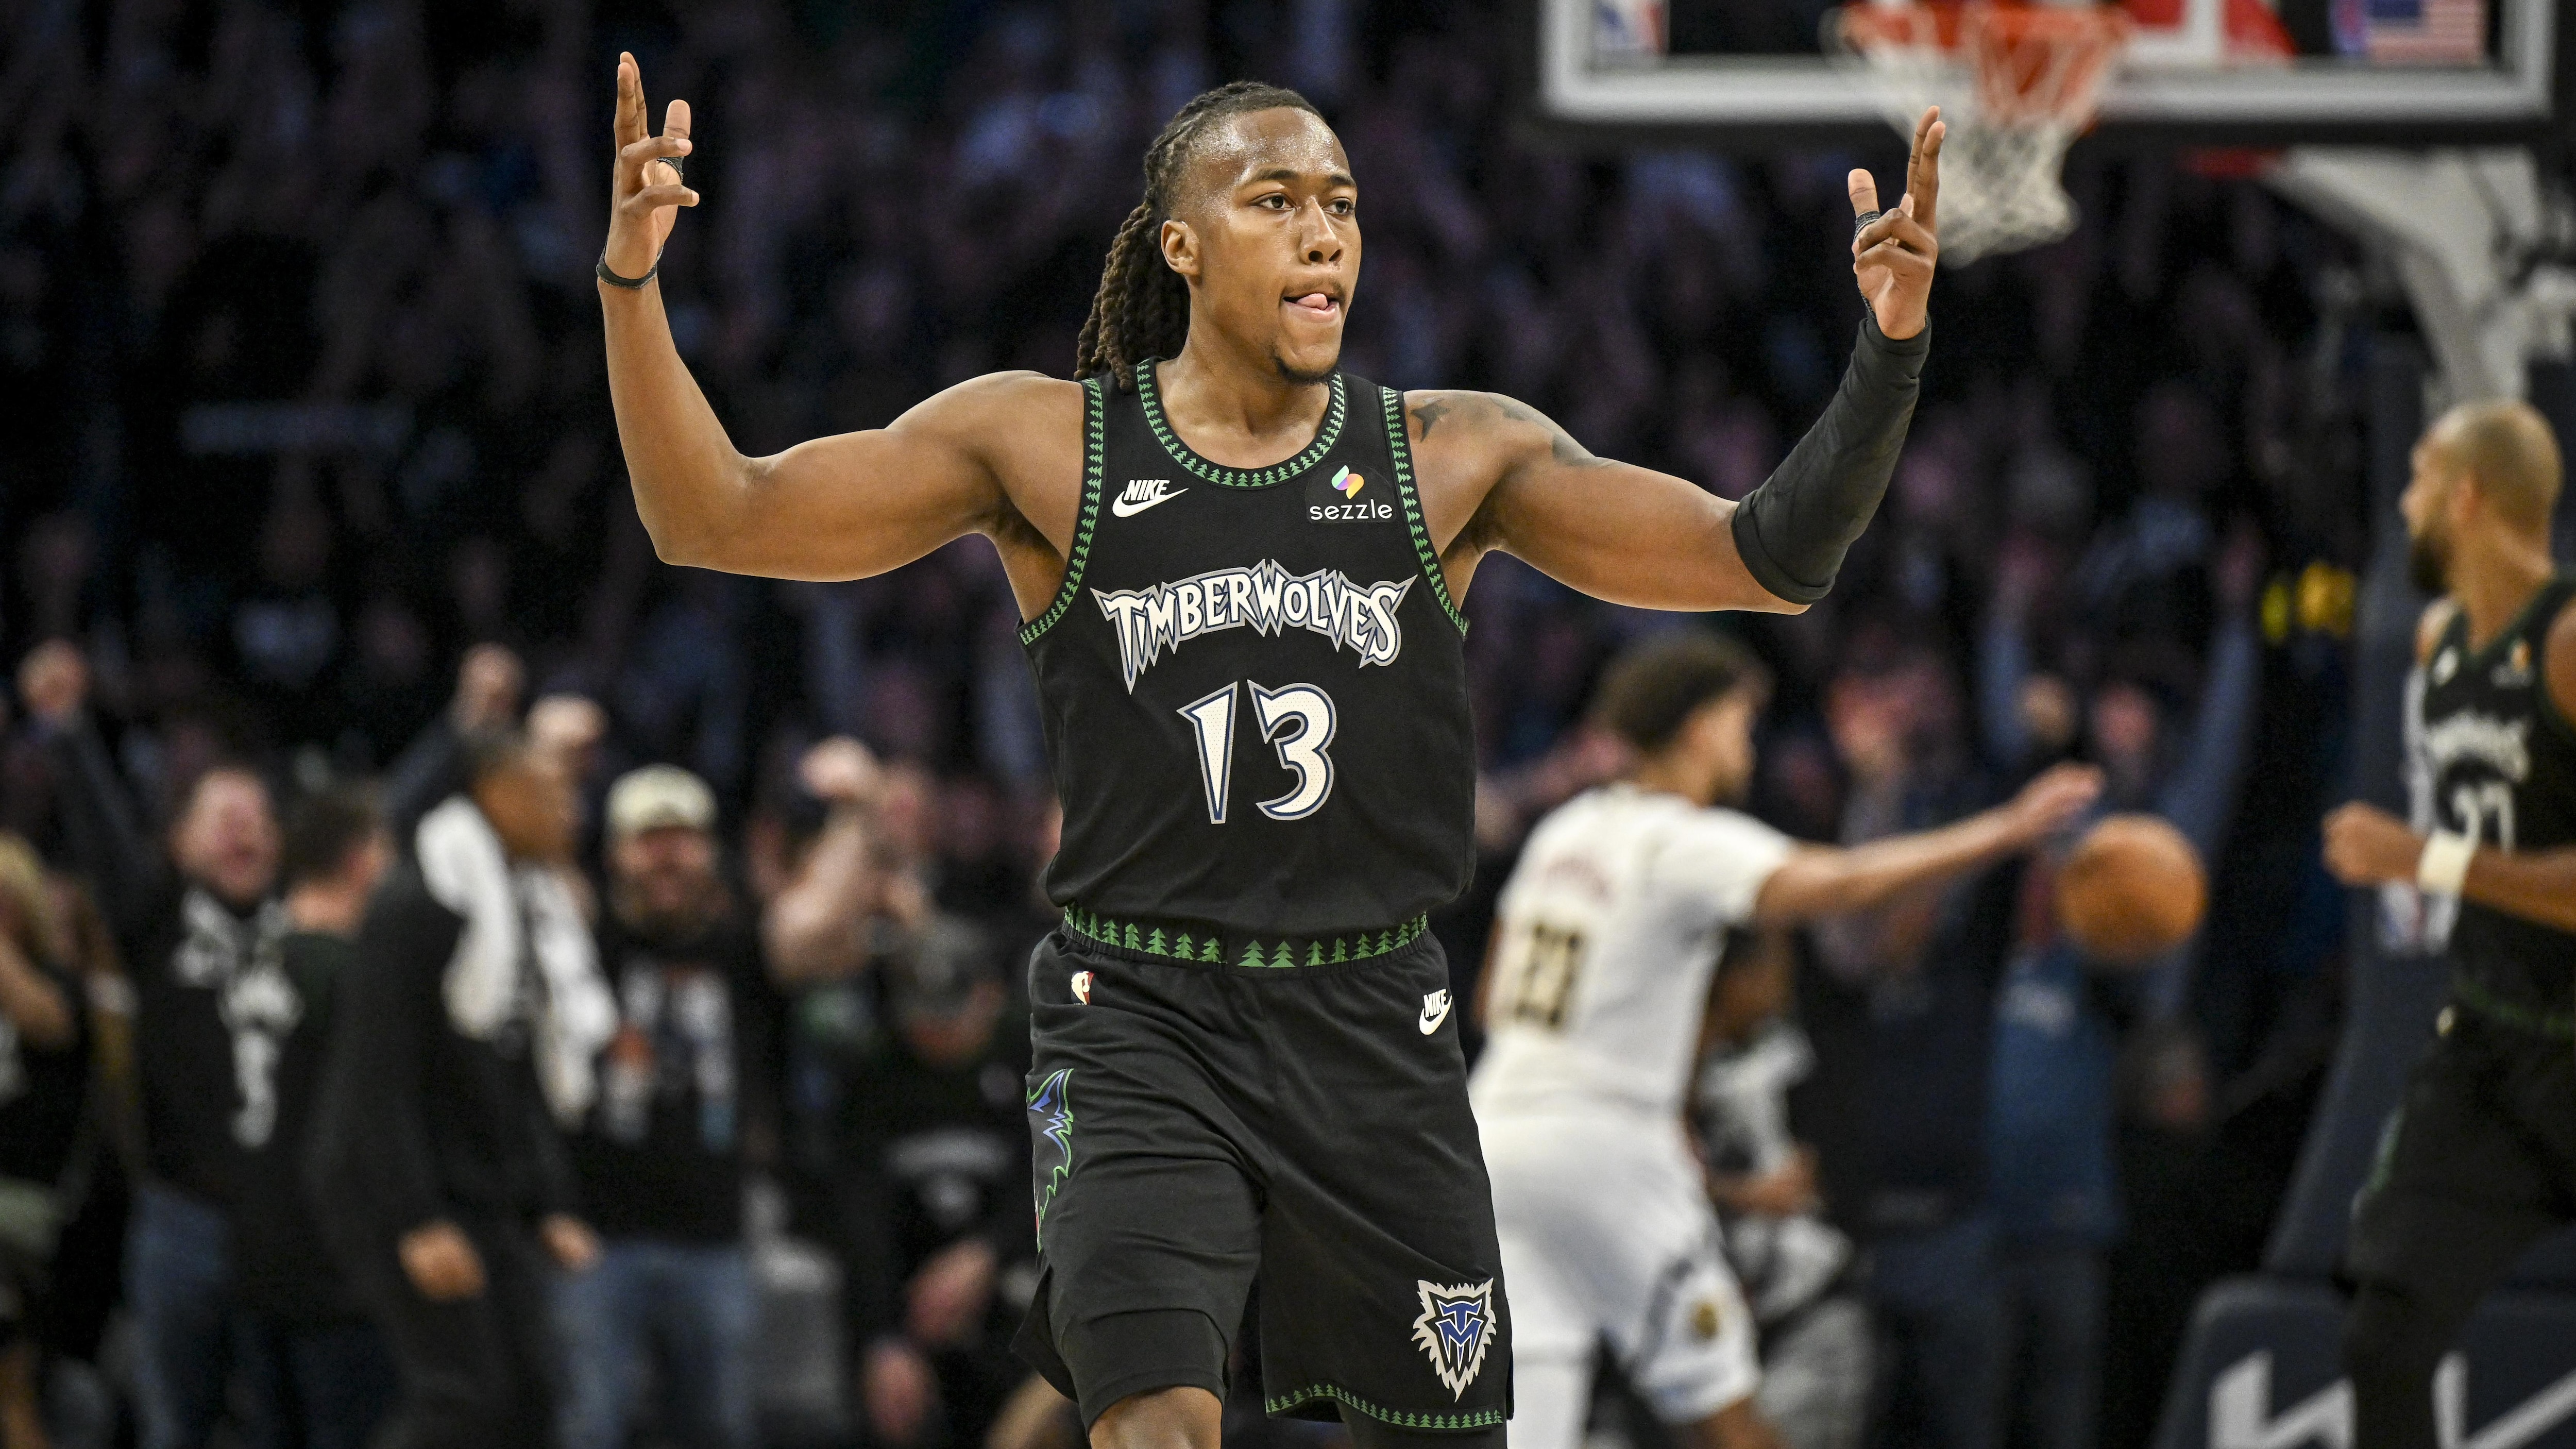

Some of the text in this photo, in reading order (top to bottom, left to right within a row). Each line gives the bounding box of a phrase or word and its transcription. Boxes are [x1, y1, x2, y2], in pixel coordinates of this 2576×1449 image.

[1123, 479, 1170, 501] NIKE
[1310, 498, 1393, 520] sezzle
[1090, 559, 1417, 695] TIMBERWOLVES
[1177, 679, 1336, 824] 13
[1423, 988, 1447, 1018] NIKE
